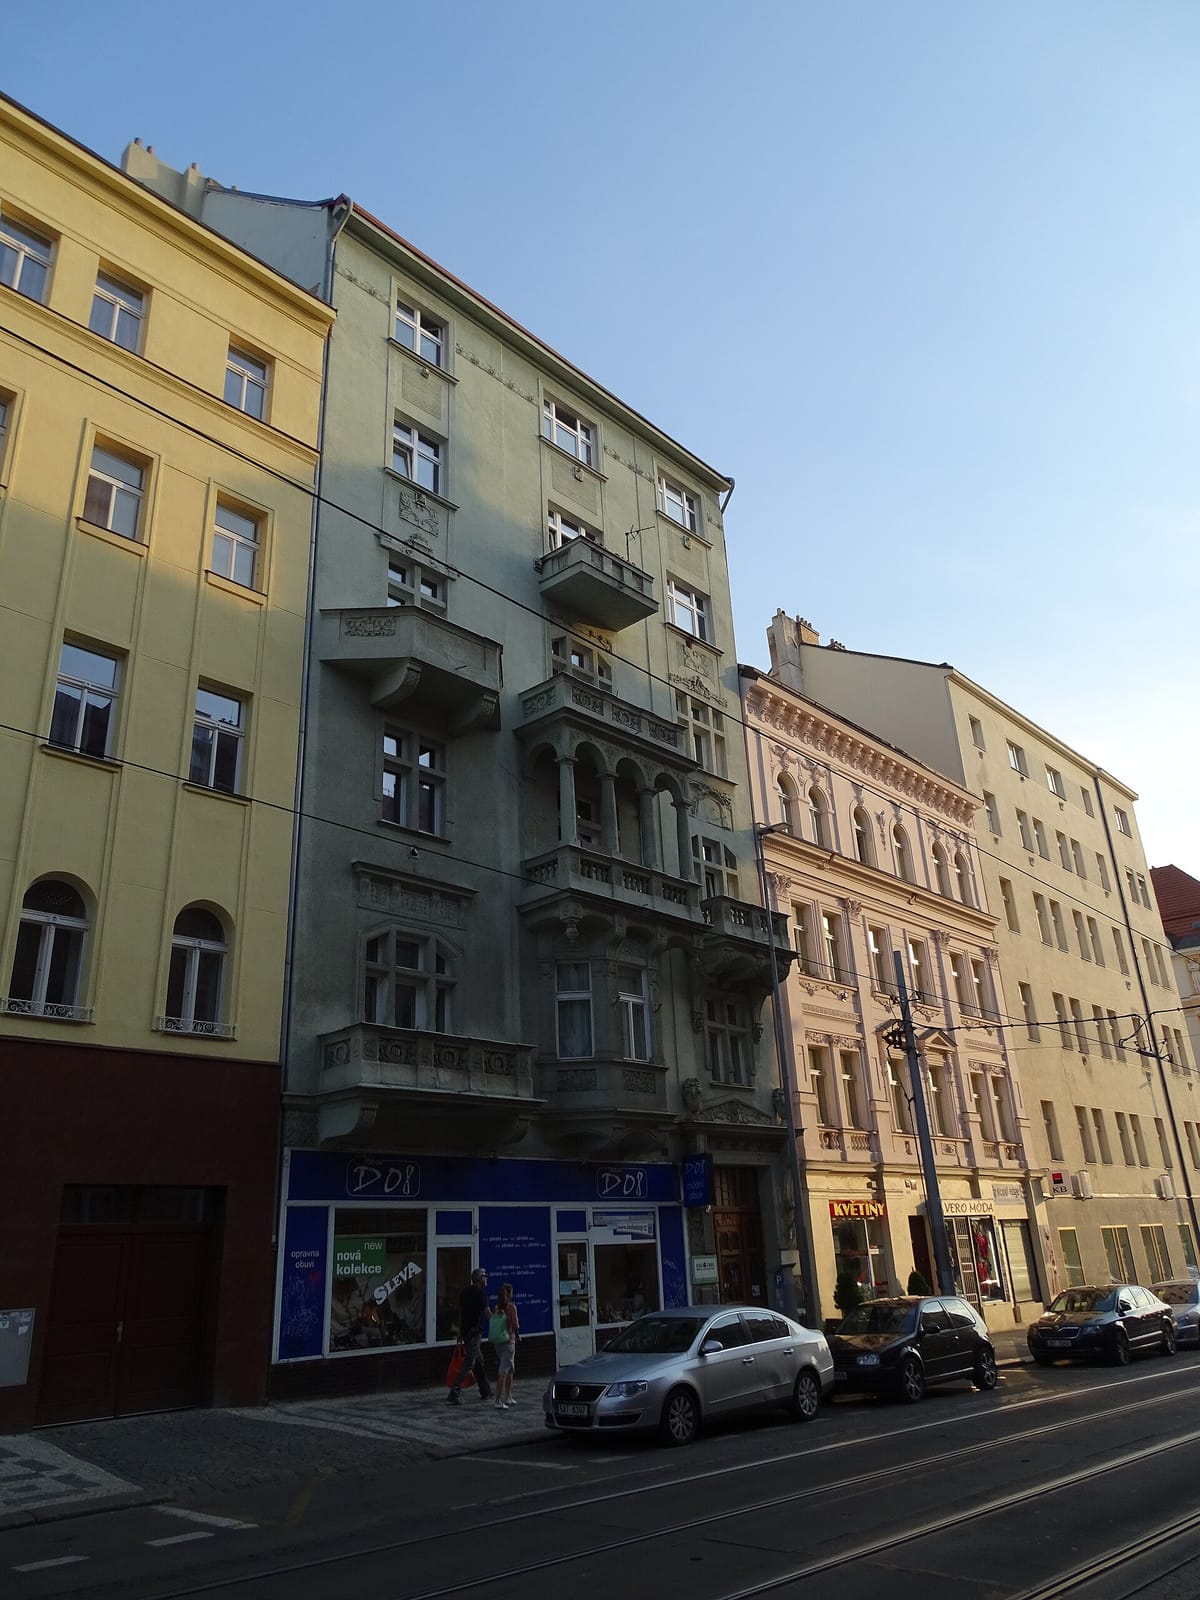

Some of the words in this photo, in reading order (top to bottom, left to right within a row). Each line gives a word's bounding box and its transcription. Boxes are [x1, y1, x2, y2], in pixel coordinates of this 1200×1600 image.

[1052, 1185, 1068, 1194] KB
[833, 1199, 885, 1216] KVĚTINY
[944, 1202, 968, 1213] VERO
[364, 1242, 383, 1250] new
[290, 1250, 320, 1259] opravna
[336, 1250, 361, 1261] nová
[336, 1263, 382, 1275] kolekce
[373, 1261, 423, 1305] SLEVA
[776, 1275, 782, 1285] P
